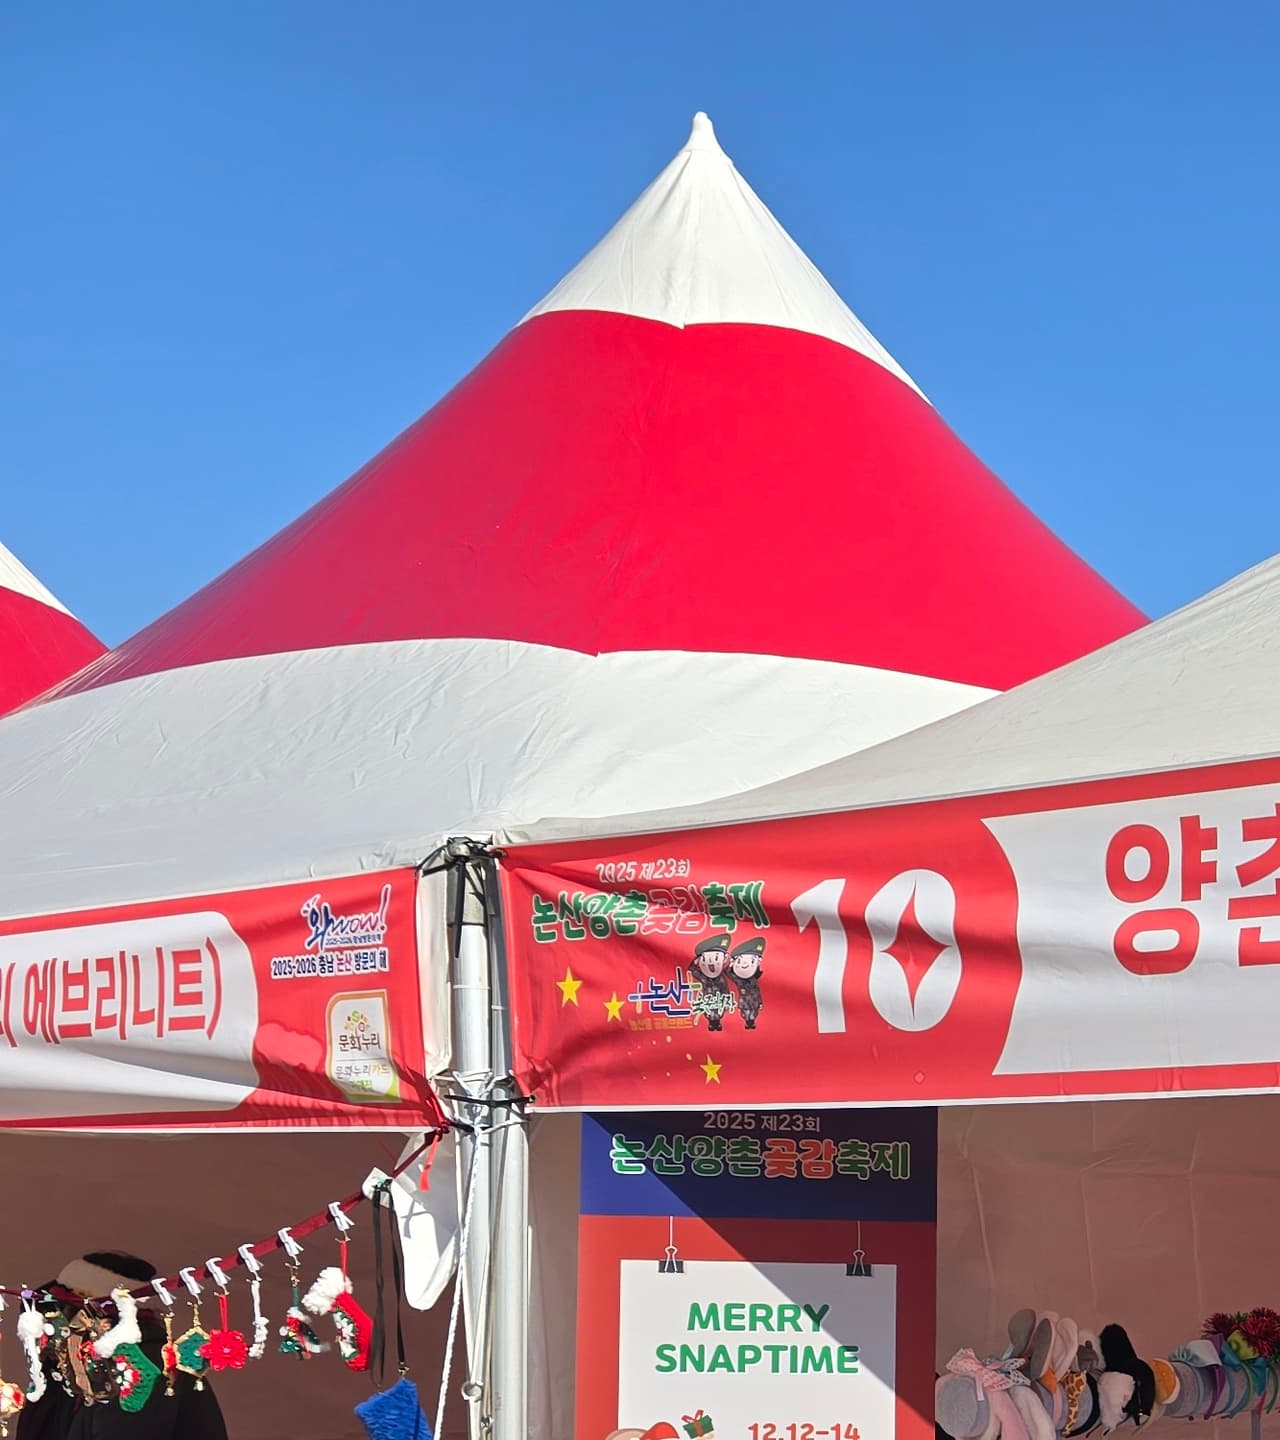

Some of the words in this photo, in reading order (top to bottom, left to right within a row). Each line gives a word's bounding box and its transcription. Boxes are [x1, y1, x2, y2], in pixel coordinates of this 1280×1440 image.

[595, 861, 637, 883] 2025
[639, 858, 690, 880] 제23회
[532, 880, 770, 943] 논산양촌곶감축제
[272, 958, 317, 977] 2025-2026
[318, 955, 333, 974] 충남
[336, 953, 351, 972] 논산
[355, 951, 376, 971] 방문의
[790, 869, 962, 1033] 10
[0, 936, 223, 1048] (에브리니트)
[338, 1031, 380, 1052] 문화누리
[703, 1112, 756, 1129] 2025
[761, 1114, 821, 1132] 제23회
[609, 1133, 911, 1180] 논산양촌곶감축제
[687, 1302, 829, 1332] MERRY
[655, 1344, 859, 1373] SNAPTIME
